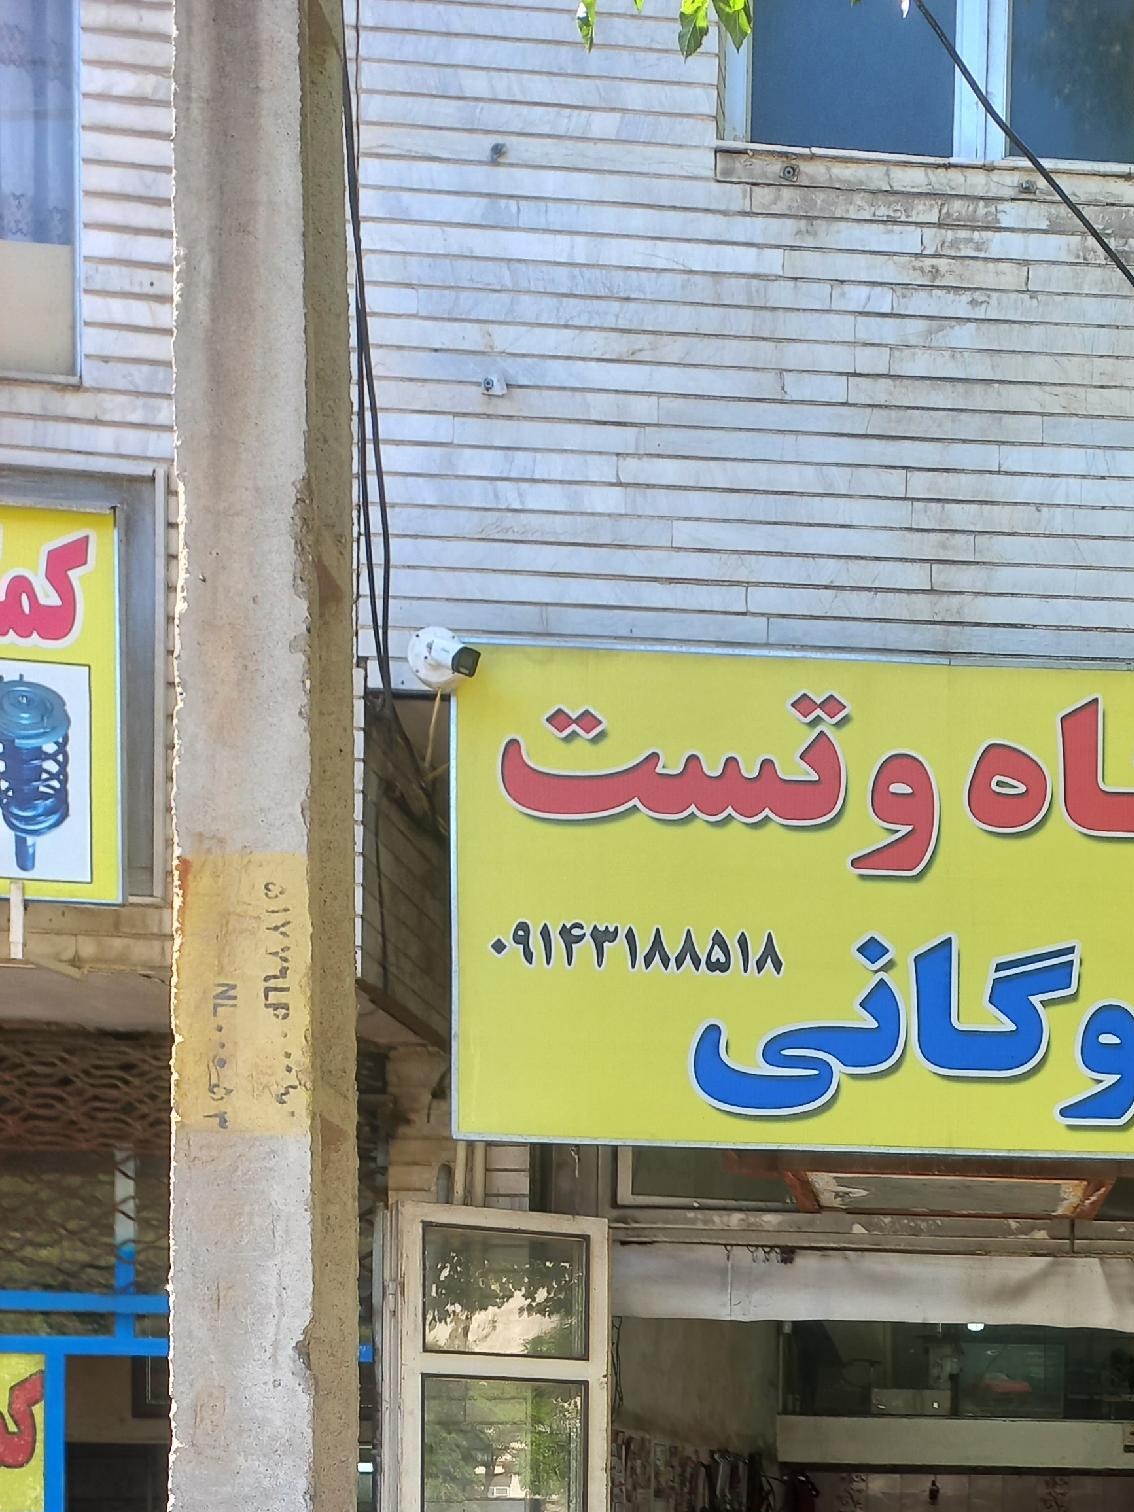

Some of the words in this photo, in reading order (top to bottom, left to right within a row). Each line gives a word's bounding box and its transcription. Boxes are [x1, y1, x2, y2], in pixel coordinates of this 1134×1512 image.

[0, 534, 90, 643] کم
[501, 695, 846, 824] تست
[851, 753, 937, 874] و
[489, 919, 784, 976] ۰۹۱۴۳۱۸۸۵۱۸
